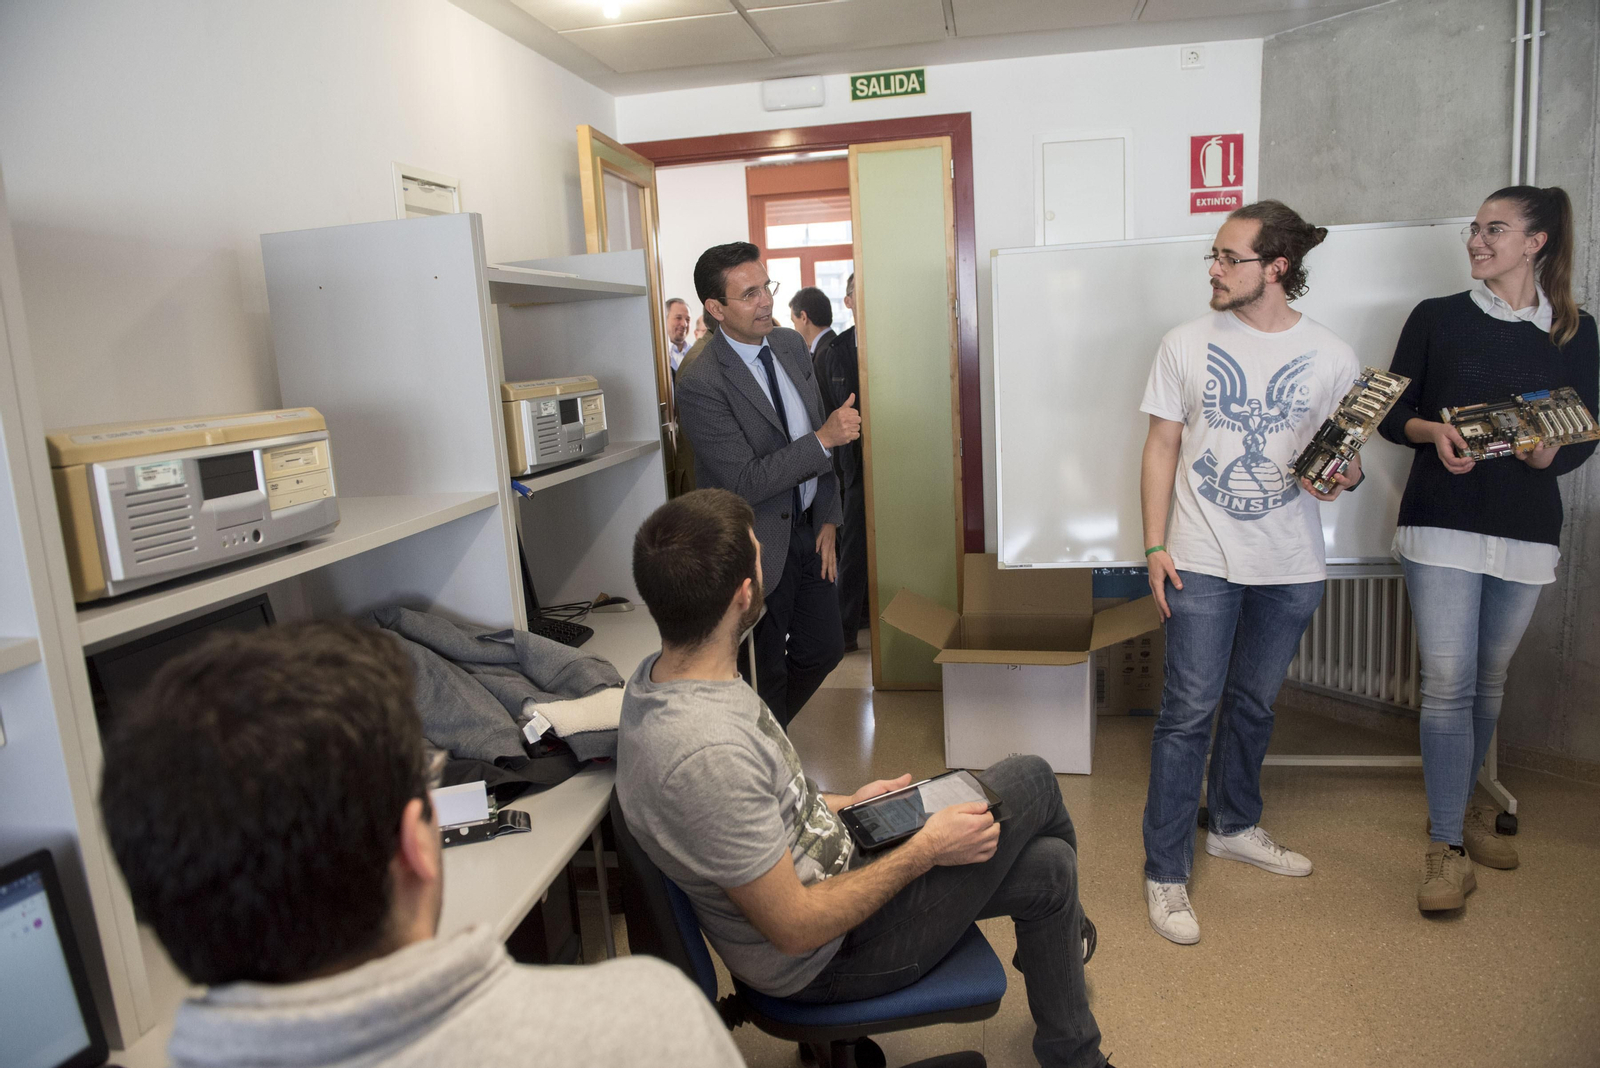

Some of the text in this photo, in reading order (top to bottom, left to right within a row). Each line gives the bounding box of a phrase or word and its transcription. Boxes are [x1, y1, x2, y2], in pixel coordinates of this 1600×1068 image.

[855, 73, 921, 97] SALIDA
[1196, 196, 1238, 207] EXTINTOR
[1215, 493, 1283, 512] UNSC
